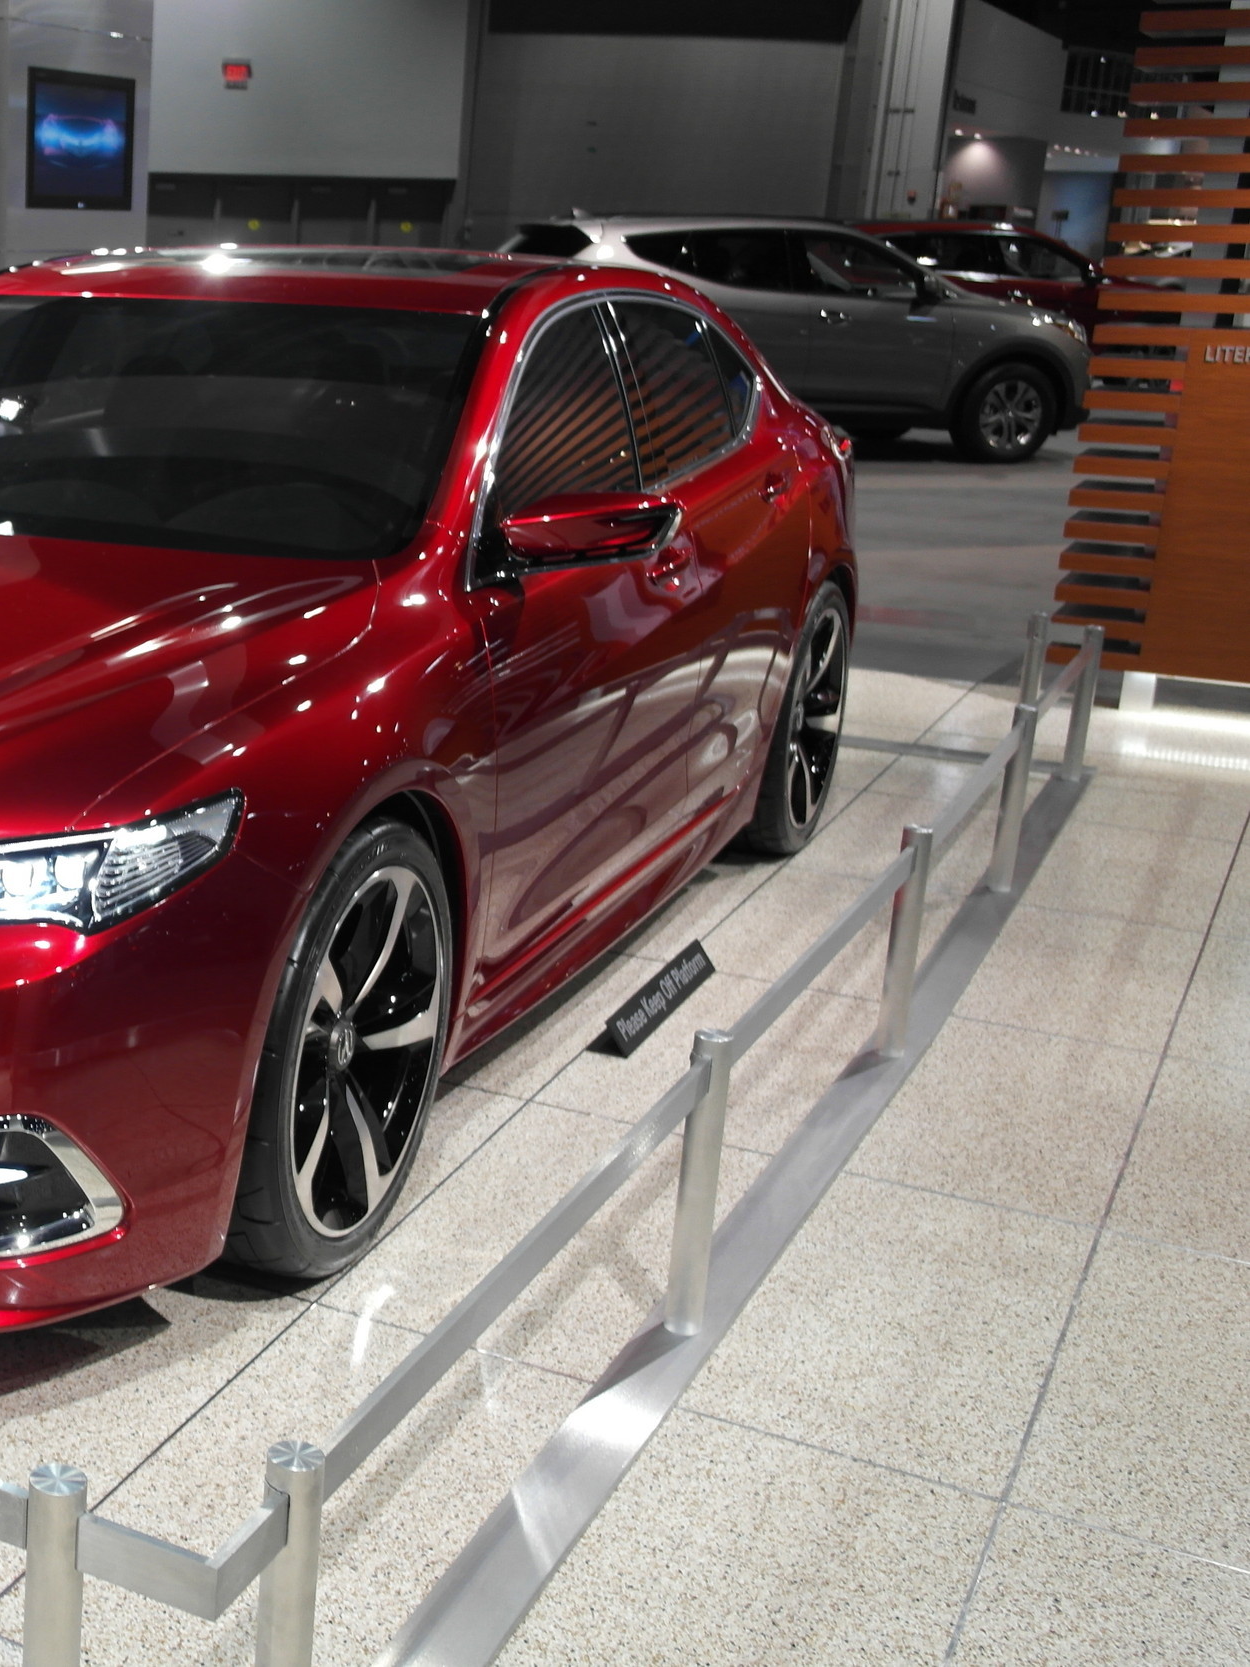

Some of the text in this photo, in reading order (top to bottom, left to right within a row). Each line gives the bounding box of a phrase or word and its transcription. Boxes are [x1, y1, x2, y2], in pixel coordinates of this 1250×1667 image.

[616, 953, 706, 1042] Please Keep Off Platform
